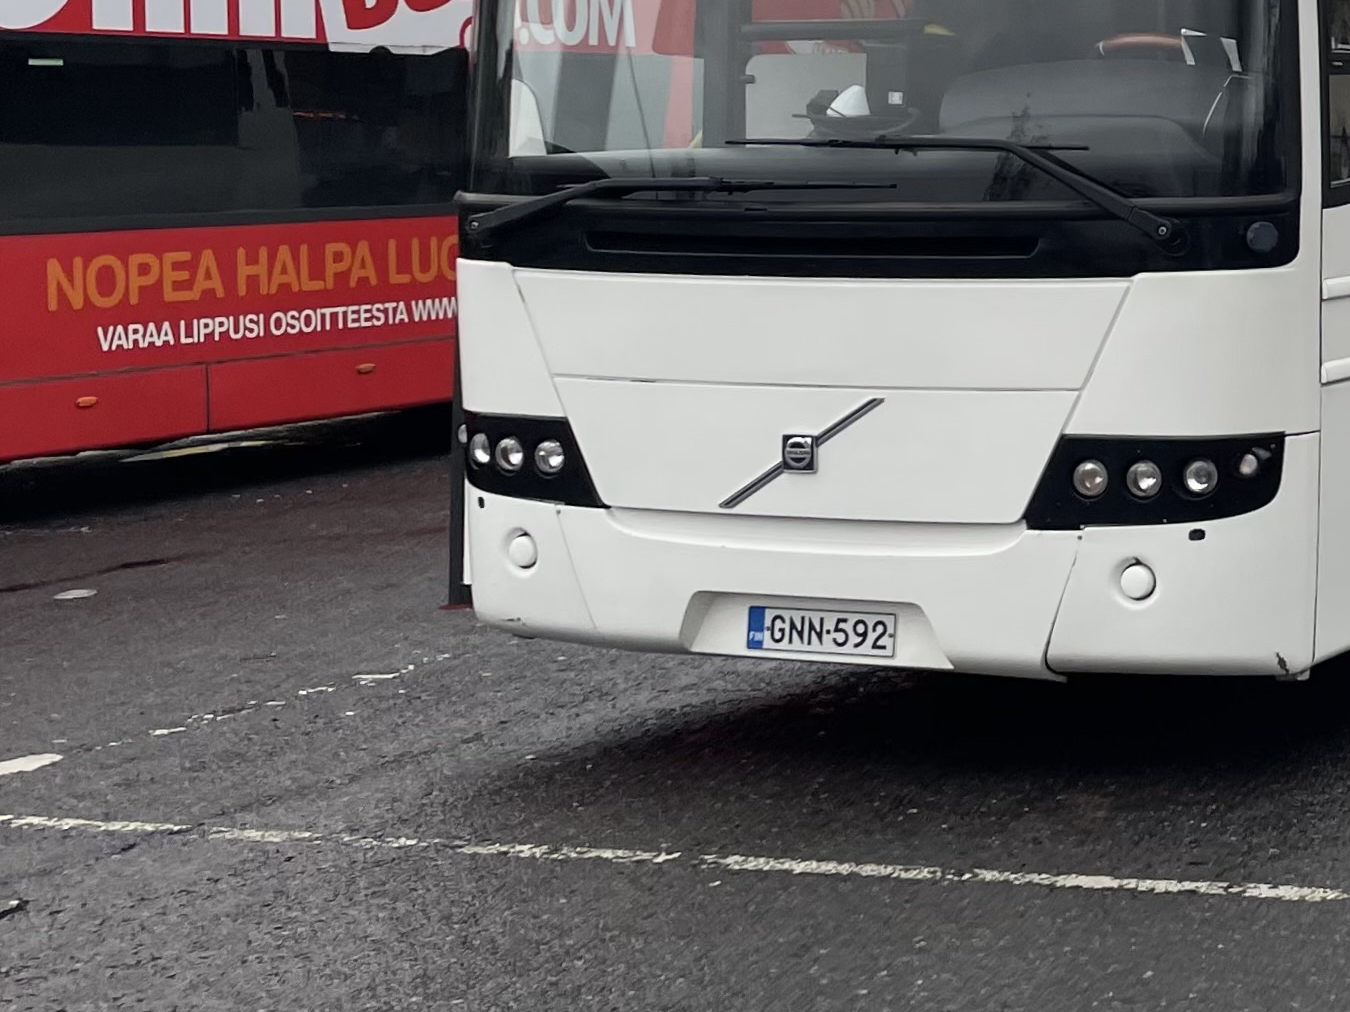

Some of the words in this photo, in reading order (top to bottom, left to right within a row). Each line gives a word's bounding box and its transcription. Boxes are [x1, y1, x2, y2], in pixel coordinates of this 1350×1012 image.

[46, 249, 223, 312] NOPEA
[237, 239, 377, 297] HALPA
[97, 320, 174, 351] VARAA
[180, 313, 265, 344] LIPPUSI
[270, 301, 409, 336] OSOITTEESTA
[770, 614, 887, 650] GNN-592
